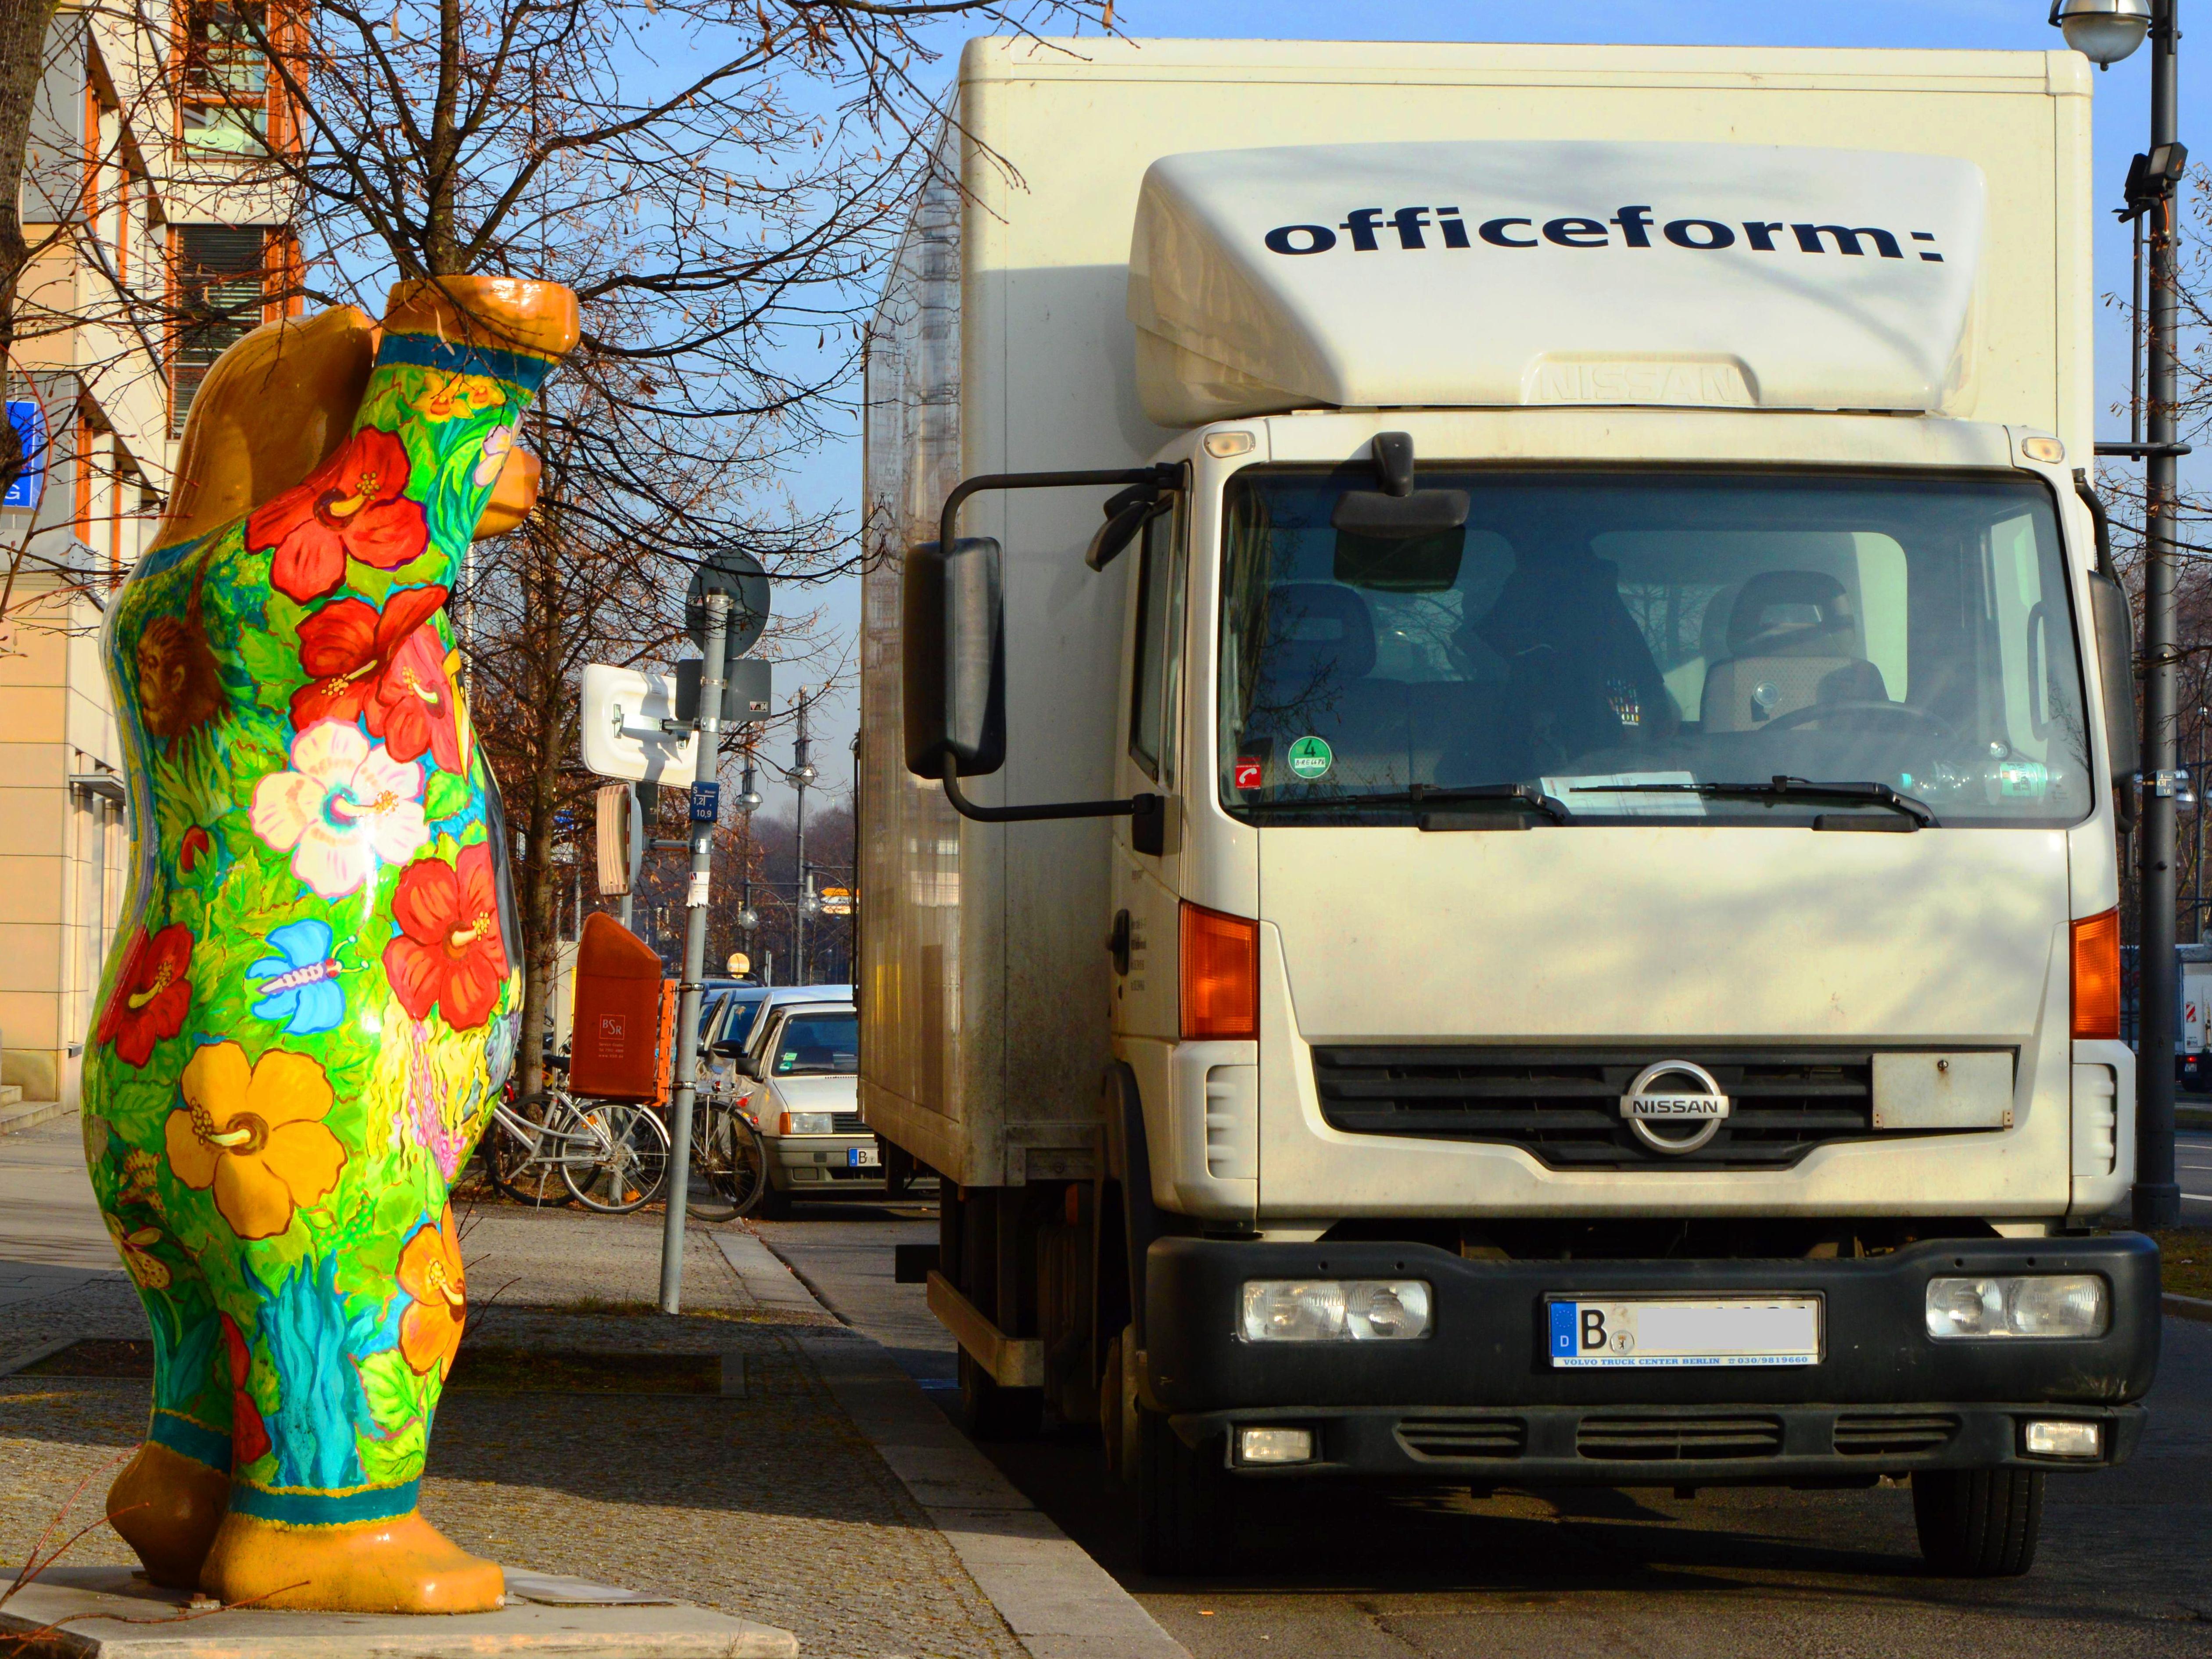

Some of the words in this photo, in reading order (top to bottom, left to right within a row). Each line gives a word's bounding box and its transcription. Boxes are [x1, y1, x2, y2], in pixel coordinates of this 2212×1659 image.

[1264, 206, 1943, 262] officeform:
[1539, 361, 1743, 403] NISSAN
[1304, 739, 1316, 757] 4
[693, 797, 703, 806] 1,2
[696, 809, 712, 819] 10,9
[602, 1019, 622, 1035] BSR
[1633, 1100, 1717, 1113] NISSAN
[859, 1151, 867, 1164] B
[1581, 1309, 1607, 1349] B
[1560, 1335, 1569, 1347] D
